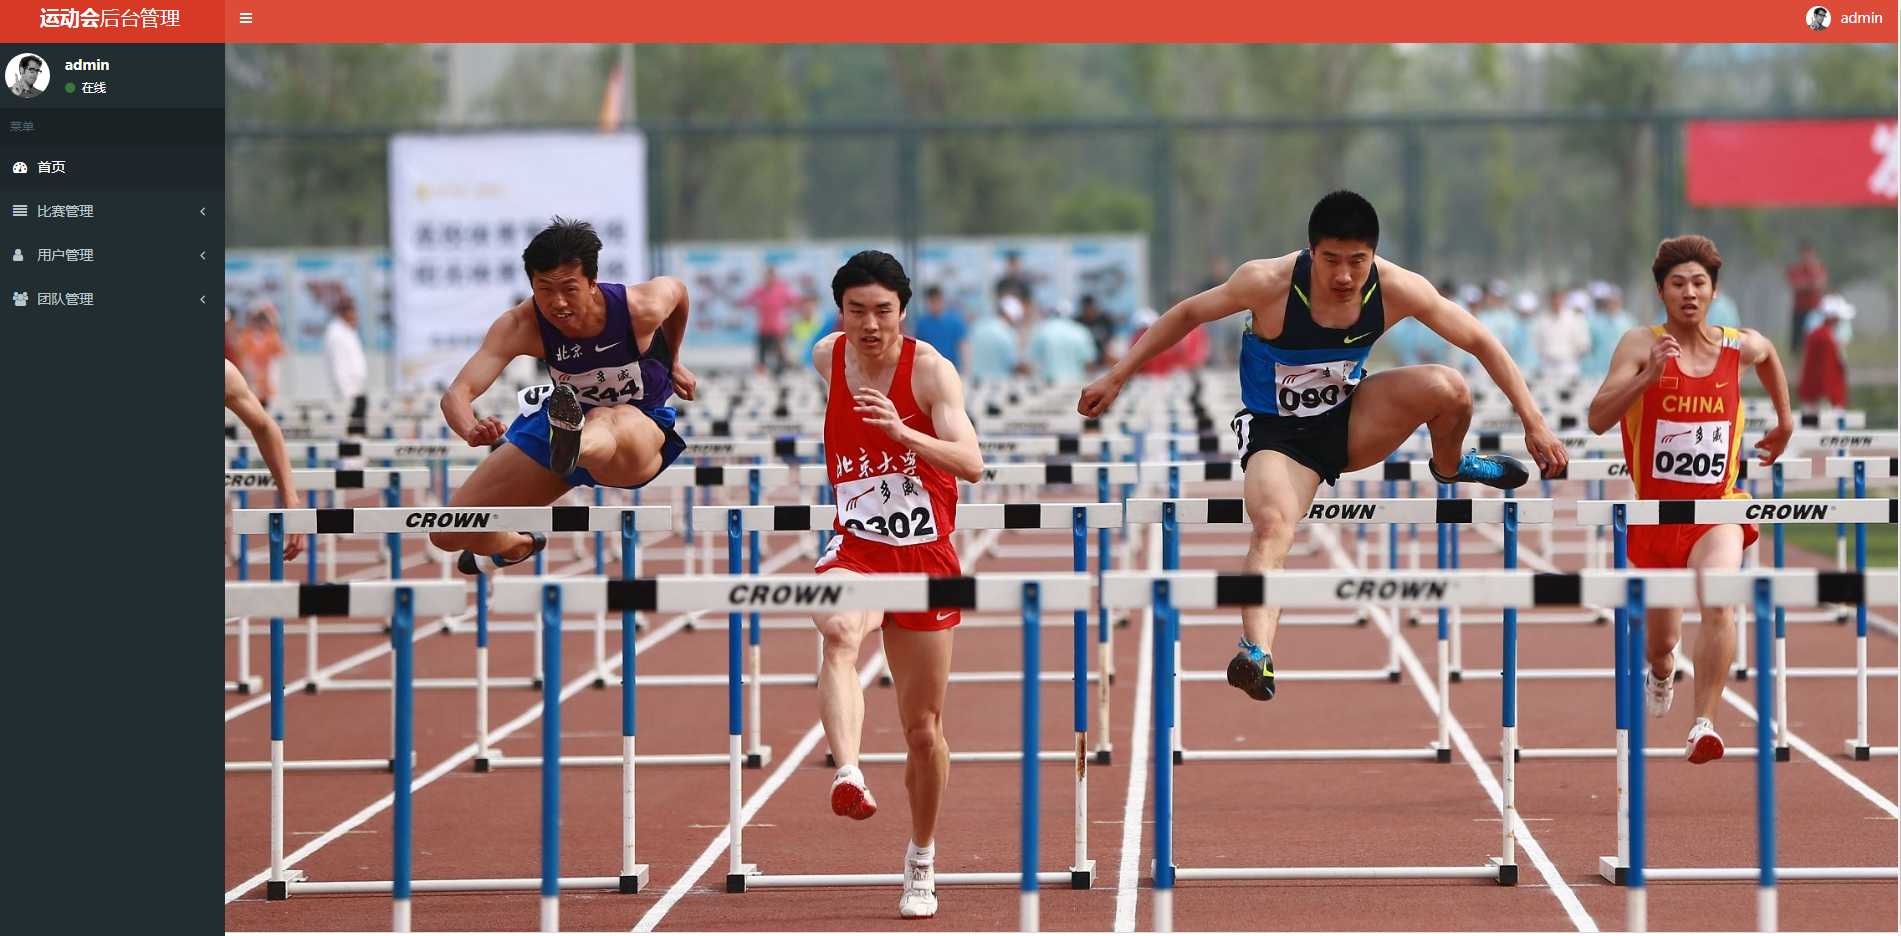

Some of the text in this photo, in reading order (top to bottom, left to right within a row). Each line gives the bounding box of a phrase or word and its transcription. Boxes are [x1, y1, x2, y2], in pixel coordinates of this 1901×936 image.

[39, 7, 181, 29] 运动会后台管理
[1840, 11, 1883, 24] admin
[64, 58, 110, 71] admin
[81, 81, 107, 94] 在线
[9, 120, 35, 133] 菜单
[37, 160, 66, 174] 首页
[37, 204, 95, 218] 比赛管理
[37, 248, 95, 262] 用户管理
[37, 292, 95, 306] 团队管理
[555, 343, 583, 362] 北京
[559, 378, 641, 402] 244
[1662, 395, 1725, 414] CHINA
[1819, 437, 1873, 448] CROWN
[1655, 451, 1726, 478] 0205
[405, 512, 491, 528] CROWN
[1302, 504, 1377, 520] ROWN
[1745, 504, 1829, 520] CROWN
[729, 584, 842, 605] CROWN
[1336, 579, 1448, 600] CROWN
